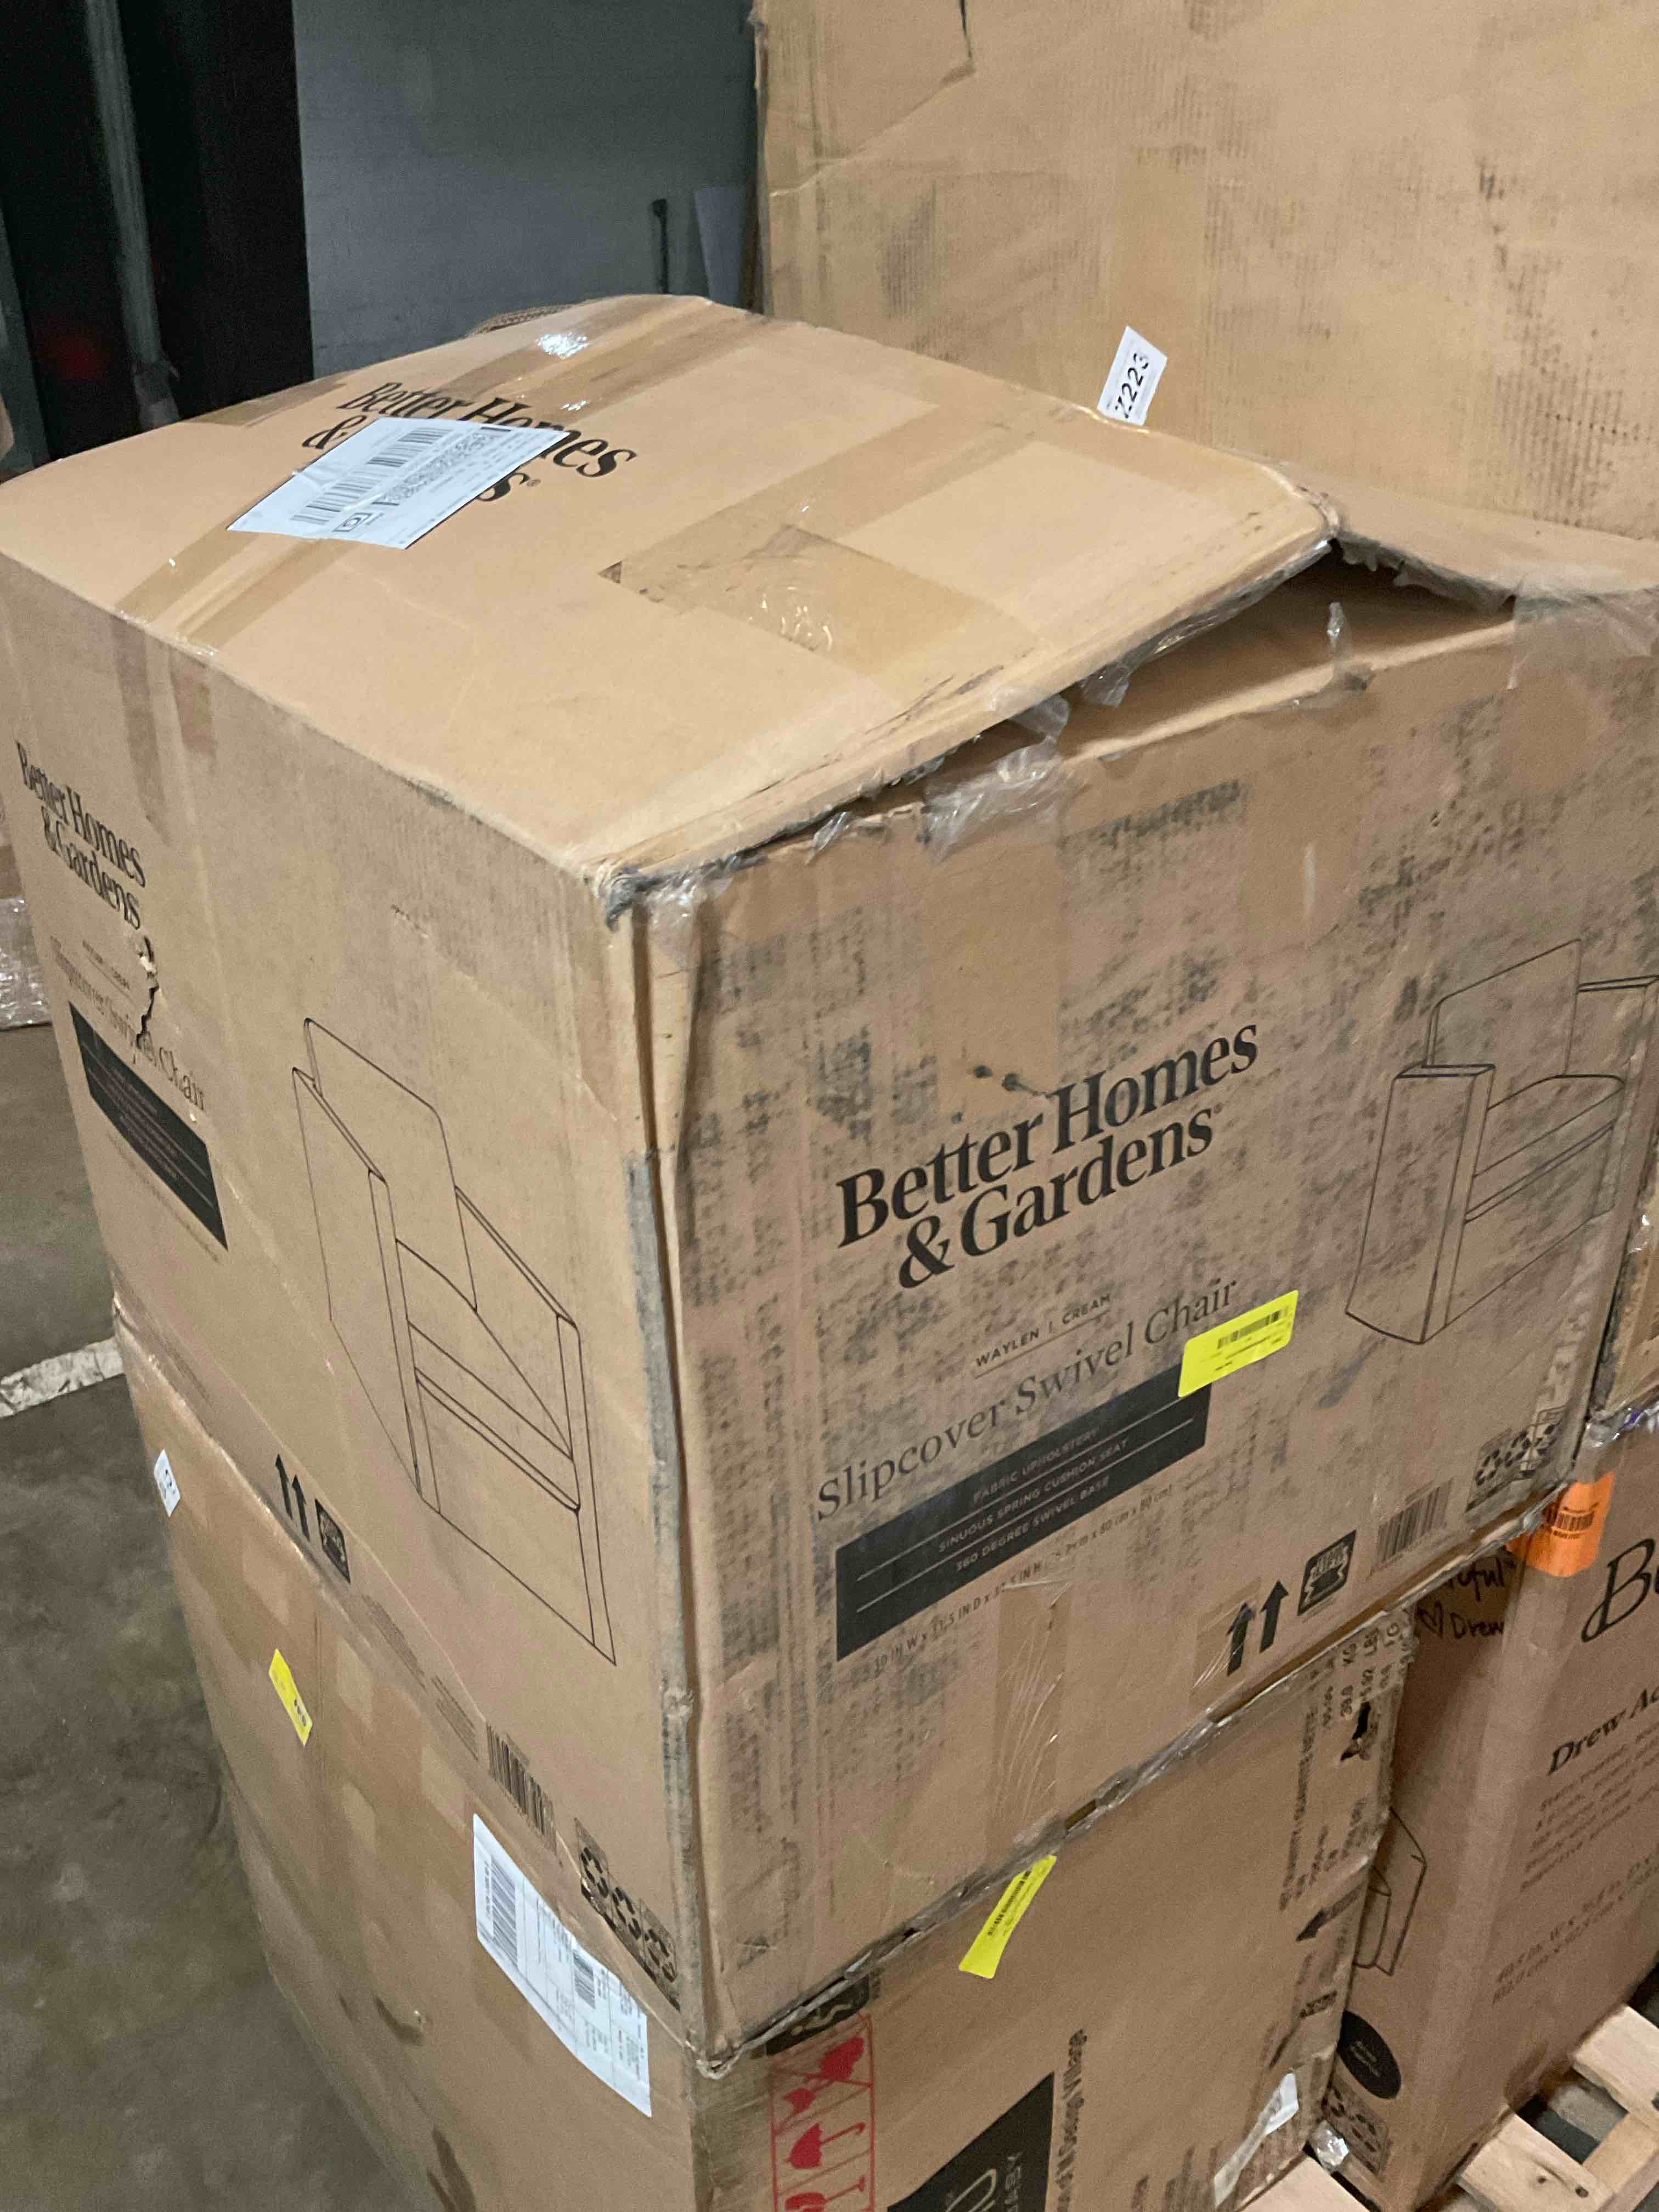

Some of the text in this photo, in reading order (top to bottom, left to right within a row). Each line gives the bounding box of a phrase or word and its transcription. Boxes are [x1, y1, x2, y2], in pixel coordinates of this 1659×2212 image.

[64, 784, 145, 888] Homes
[836, 1024, 1258, 1248] Better Homes
[898, 1214, 955, 1289] &
[975, 1328, 1040, 1367] WAYLEN
[1062, 1294, 1111, 1324] CREAM
[817, 1400, 1006, 1521] Slipcover
[1016, 1321, 1133, 1415] Swivel
[1144, 1277, 1237, 1344] Chair
[938, 1514, 994, 1553] SINUOUS
[996, 1488, 1041, 1519] SPRING
[1044, 1458, 1096, 1492] CUSHION
[1032, 1496, 1076, 1526] SWIVEL
[1581, 1538, 1659, 1643] B
[1546, 1708, 1628, 1777] Drew
